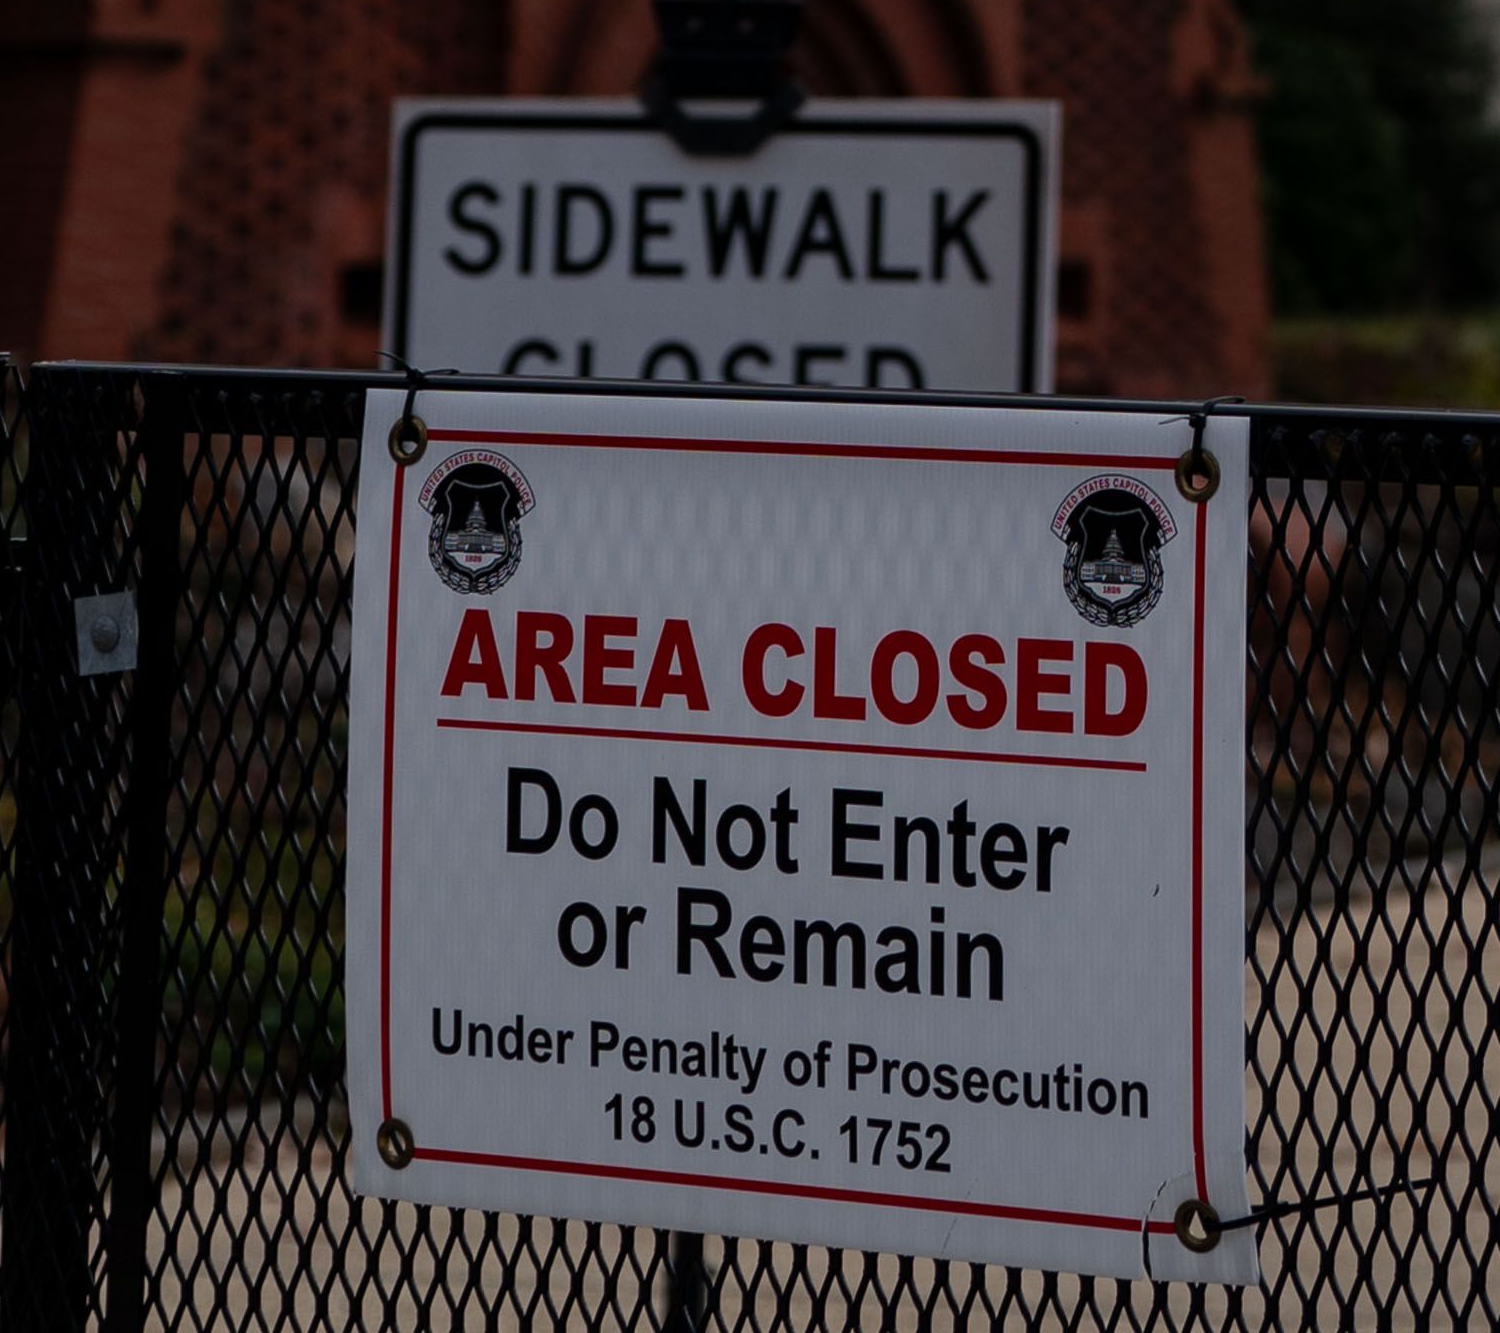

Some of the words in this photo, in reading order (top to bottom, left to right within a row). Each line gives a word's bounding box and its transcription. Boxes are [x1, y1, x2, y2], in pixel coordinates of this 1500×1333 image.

[443, 181, 991, 285] SIDEWALK
[421, 469, 444, 502] UNITED
[444, 453, 474, 471] STATES
[477, 453, 510, 474] CAPITOL
[511, 471, 532, 506] POLICE
[1054, 495, 1077, 530] UNITED
[1078, 478, 1110, 499] STATES
[1113, 478, 1149, 500] CAPITOL
[1149, 498, 1174, 535] POLICE
[441, 609, 709, 711] AREA
[743, 623, 1147, 736] CLOSED
[507, 767, 618, 860] Do
[653, 777, 798, 874] Not
[832, 788, 1070, 892] Enter
[558, 902, 646, 969] or
[677, 887, 1003, 1001] Remain
[433, 1008, 574, 1064] Under
[591, 1021, 766, 1094] Penalty
[784, 1041, 832, 1088] of
[848, 1044, 1148, 1118] Prosecution
[605, 1094, 655, 1143] 18
[675, 1100, 819, 1159] U.S.C.
[840, 1116, 950, 1172] 1752
